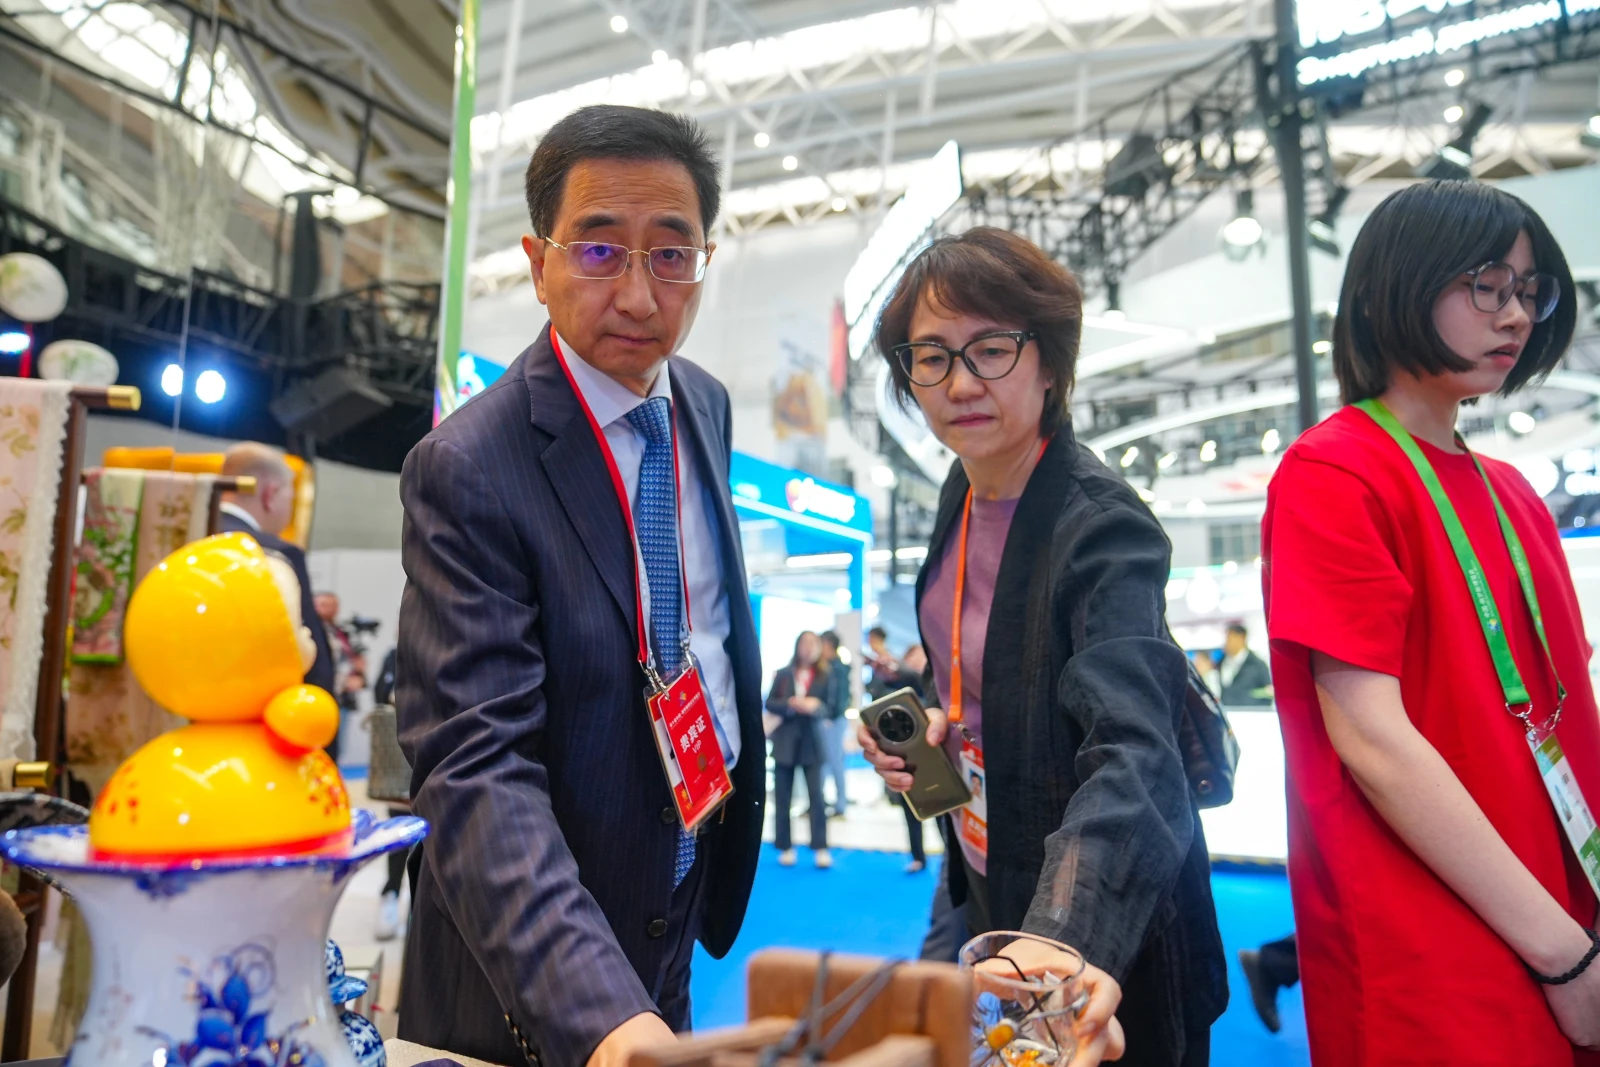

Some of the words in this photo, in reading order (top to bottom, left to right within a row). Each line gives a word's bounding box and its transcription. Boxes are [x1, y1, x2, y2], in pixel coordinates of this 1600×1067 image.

[680, 715, 706, 753] 贵宾证
[692, 739, 701, 753] VIP
